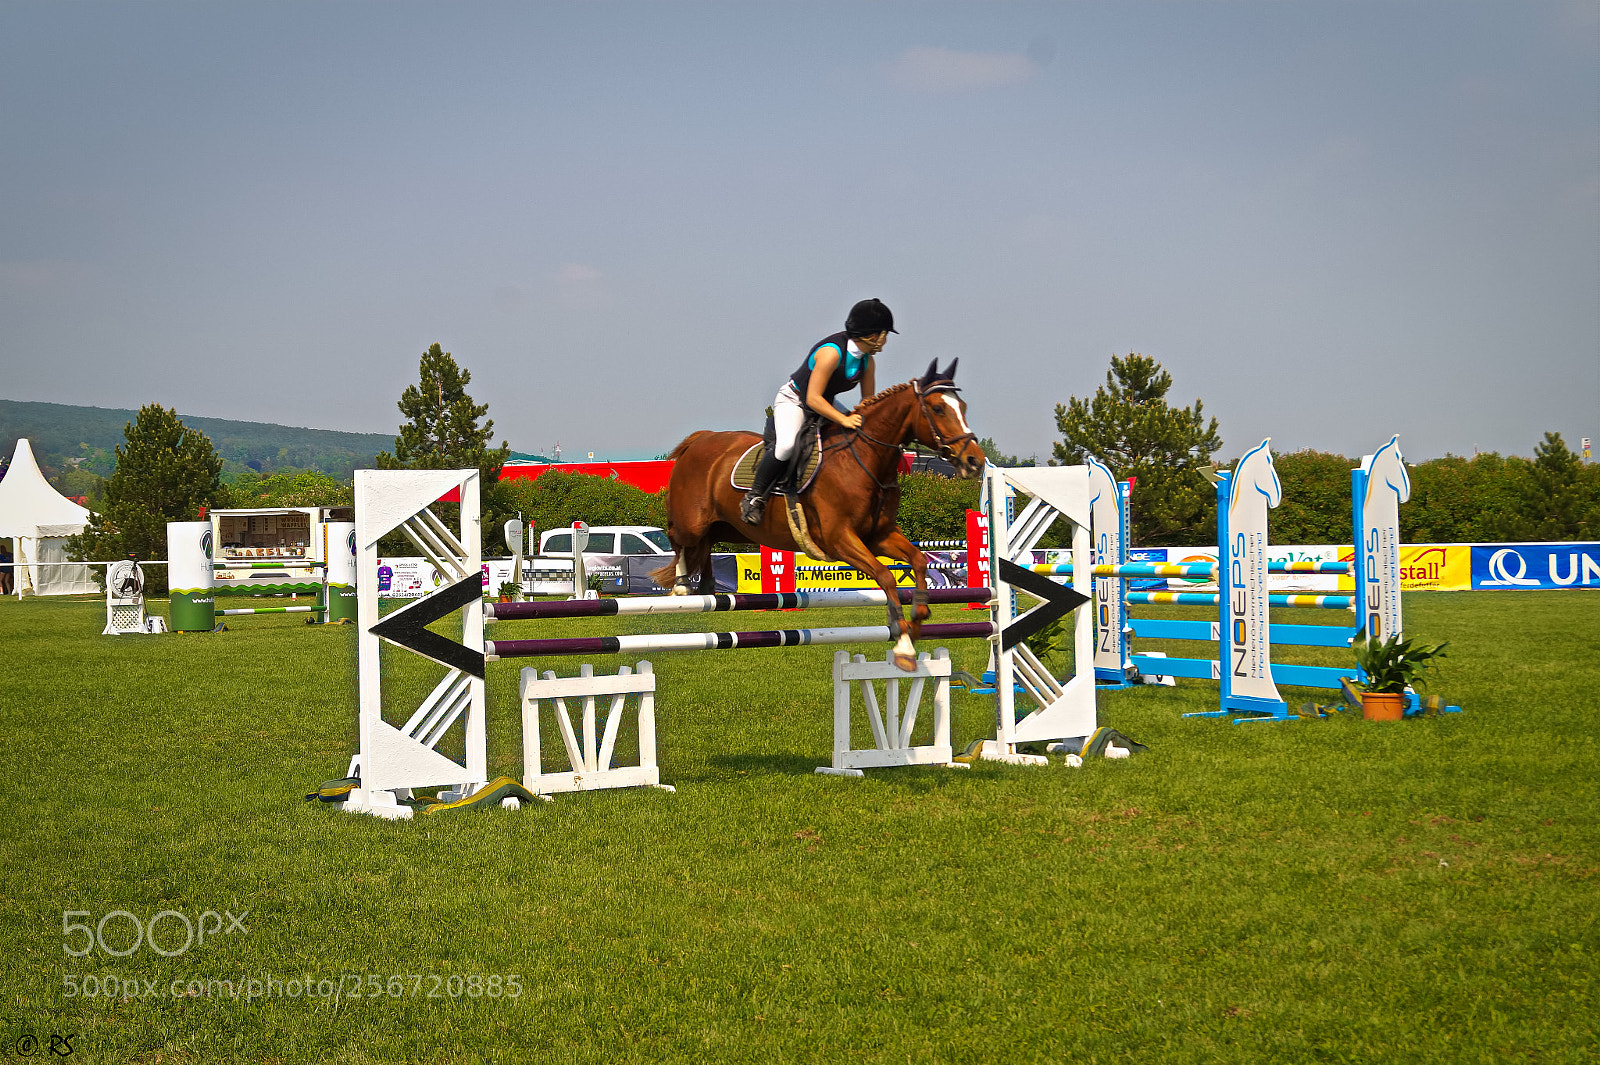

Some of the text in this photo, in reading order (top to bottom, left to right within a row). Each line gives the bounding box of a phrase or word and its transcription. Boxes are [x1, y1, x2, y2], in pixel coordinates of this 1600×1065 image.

[811, 569, 852, 581] Meine
[977, 517, 991, 588] WiNWi
[1366, 527, 1380, 638] OEPS
[1232, 532, 1247, 678] NOEPS
